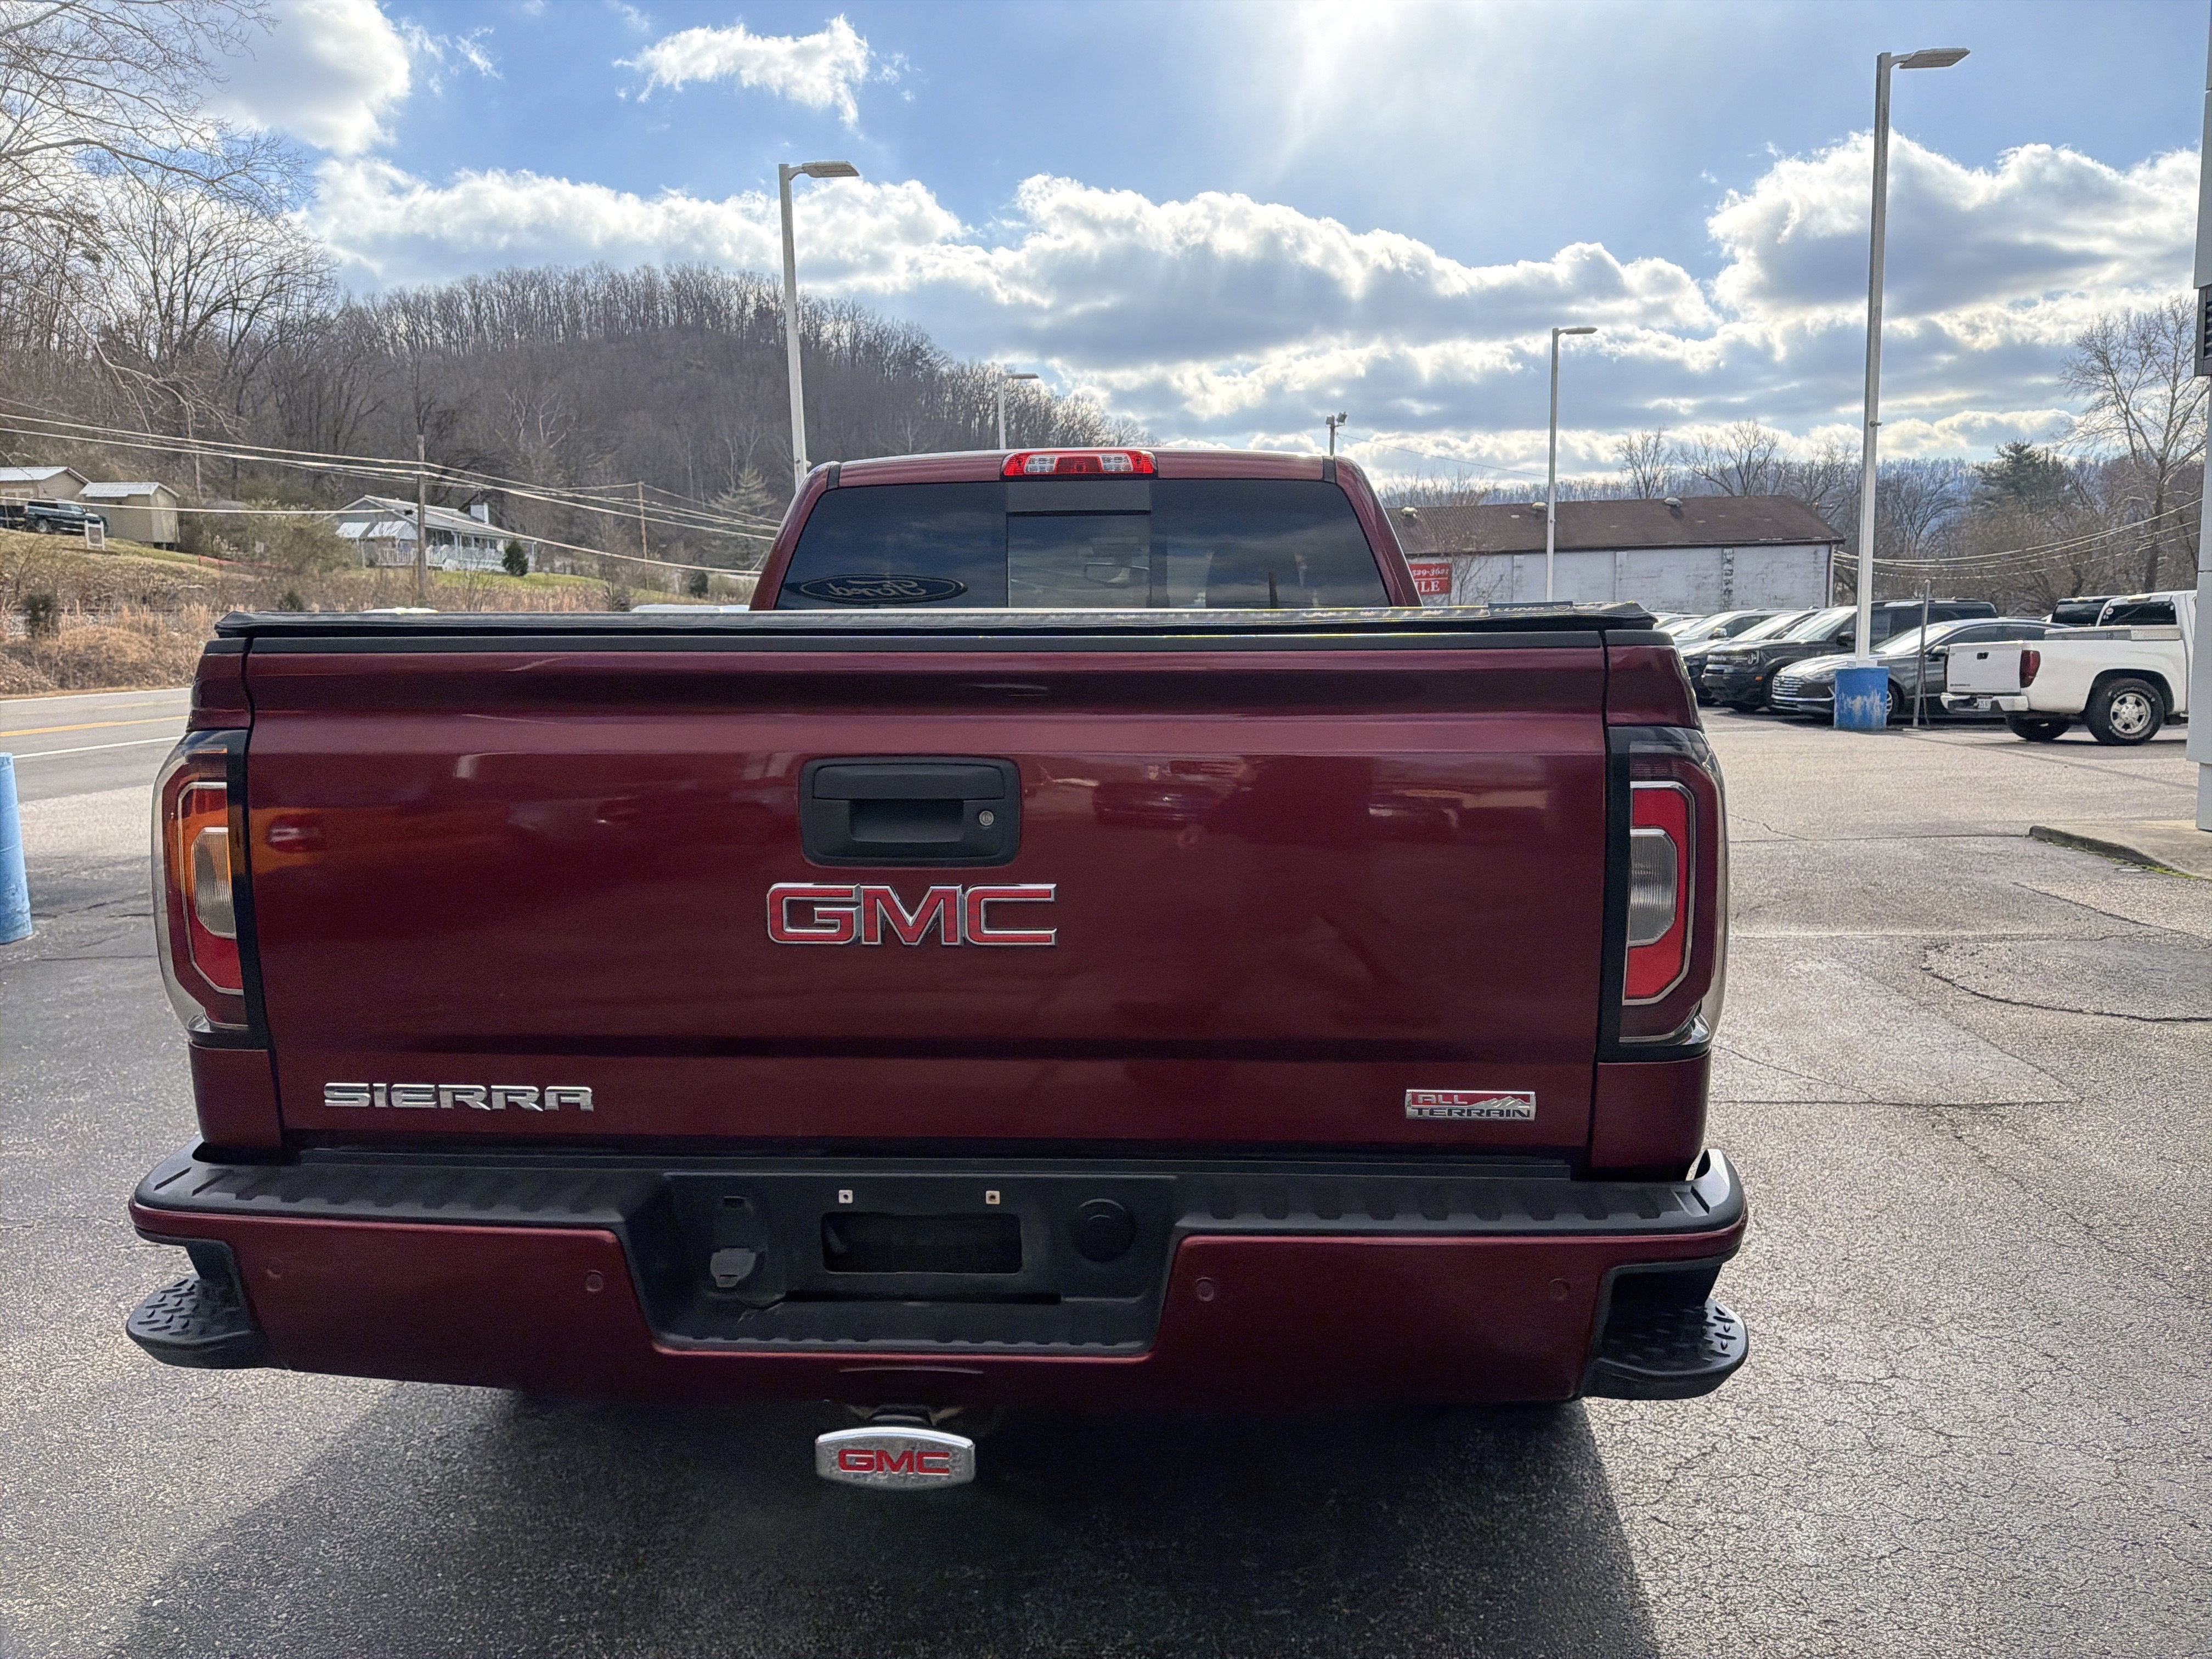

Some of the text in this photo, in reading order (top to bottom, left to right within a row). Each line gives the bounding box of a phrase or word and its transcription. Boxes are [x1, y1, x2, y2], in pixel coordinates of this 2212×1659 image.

[766, 883, 1057, 946] GMC
[324, 1082, 594, 1112] SIERRA
[1417, 1094, 1469, 1104] ALL
[1411, 1107, 1531, 1118] TERRAIN
[838, 1448, 950, 1476] GMC
